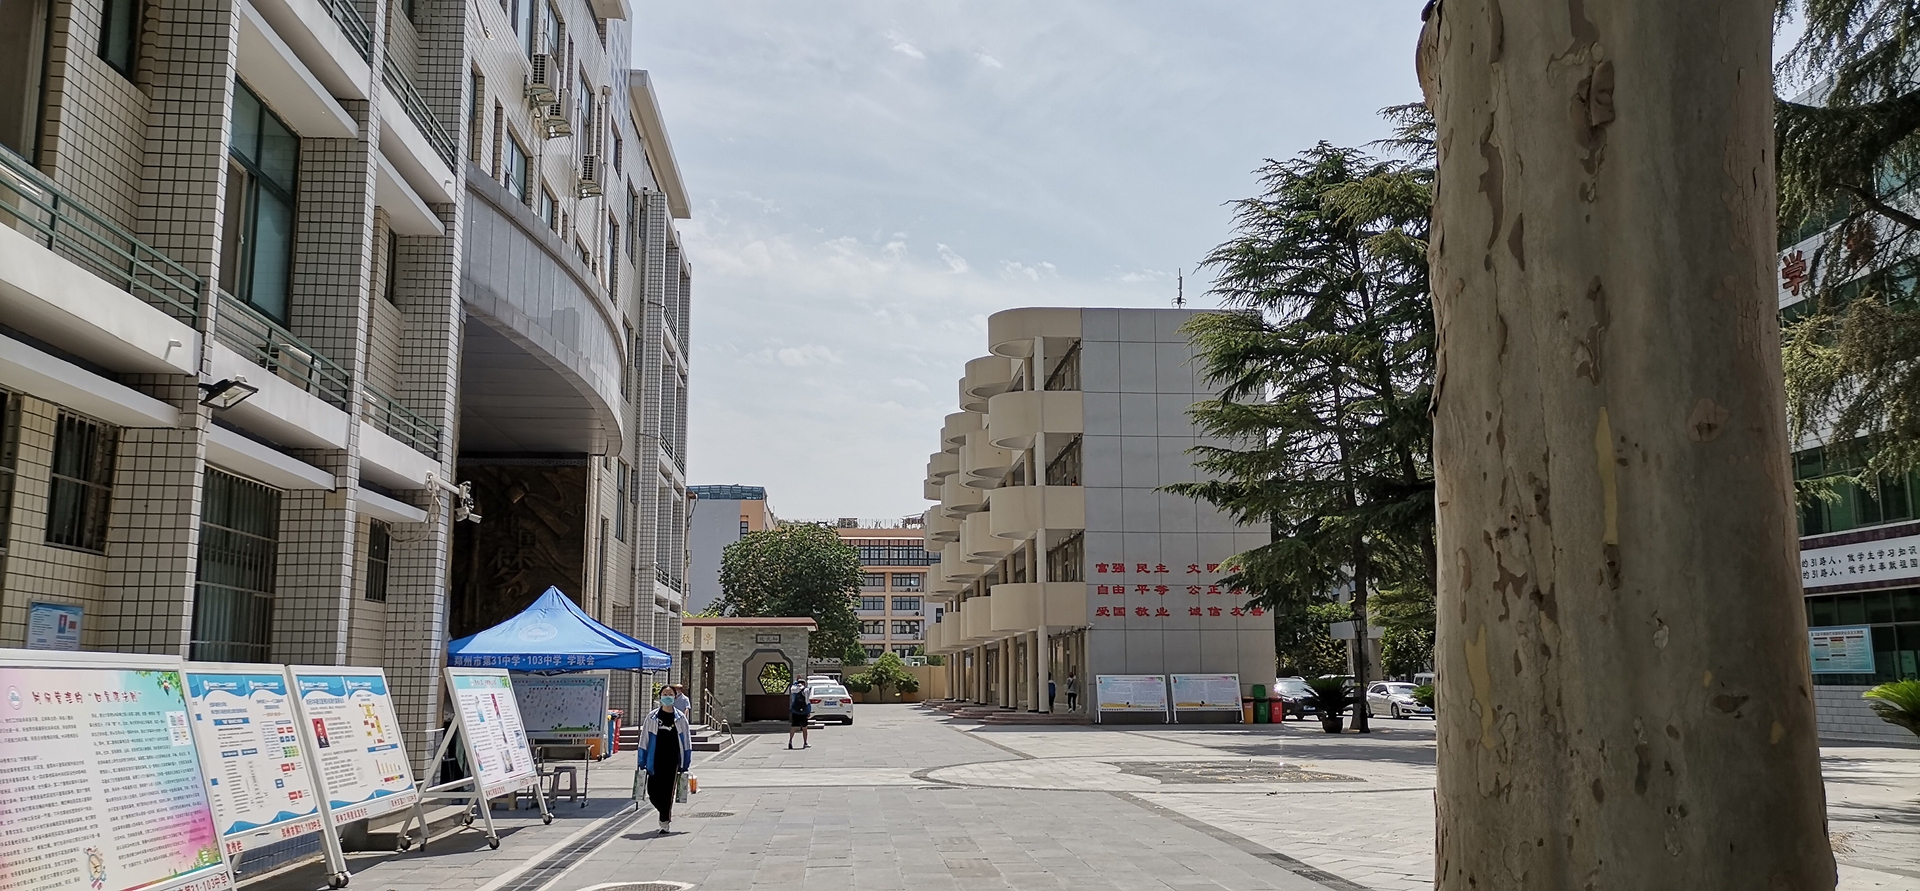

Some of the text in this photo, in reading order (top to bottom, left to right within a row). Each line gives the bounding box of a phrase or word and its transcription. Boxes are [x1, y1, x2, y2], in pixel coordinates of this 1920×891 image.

[1781, 249, 1807, 296] 学
[1095, 562, 1126, 574] 富强
[1136, 563, 1170, 574] 民主
[1186, 563, 1220, 574] 文明
[1097, 584, 1125, 595] 自由
[1134, 584, 1170, 595] 平等
[1186, 584, 1222, 595] 公正
[1095, 606, 1126, 617] 爱国
[1135, 606, 1170, 617] 敬业
[1188, 606, 1222, 617] 诚信
[567, 654, 595, 666] 学联会
